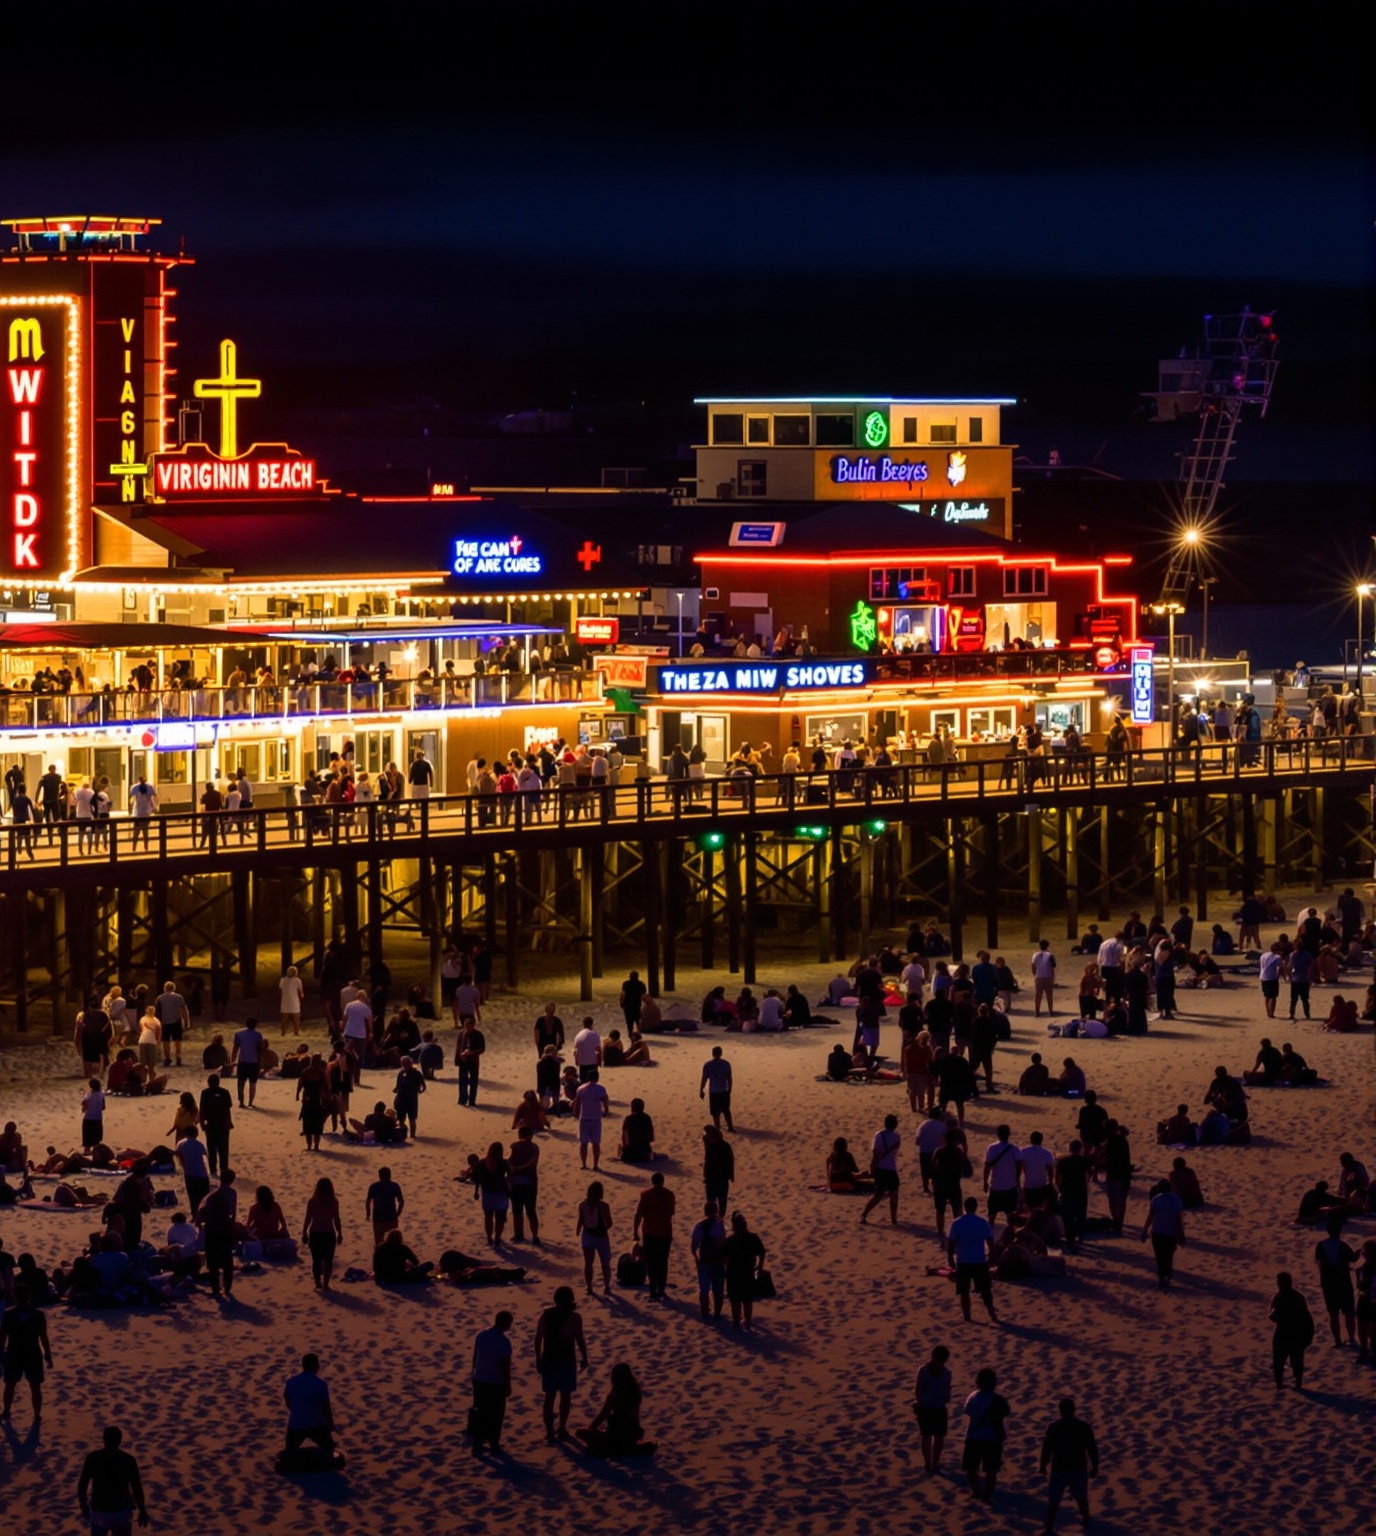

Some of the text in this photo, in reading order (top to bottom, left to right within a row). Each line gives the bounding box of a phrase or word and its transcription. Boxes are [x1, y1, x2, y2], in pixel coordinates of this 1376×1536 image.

[258, 461, 313, 489] BEACH
[455, 557, 473, 573] OF
[787, 664, 864, 686] SHOVES
